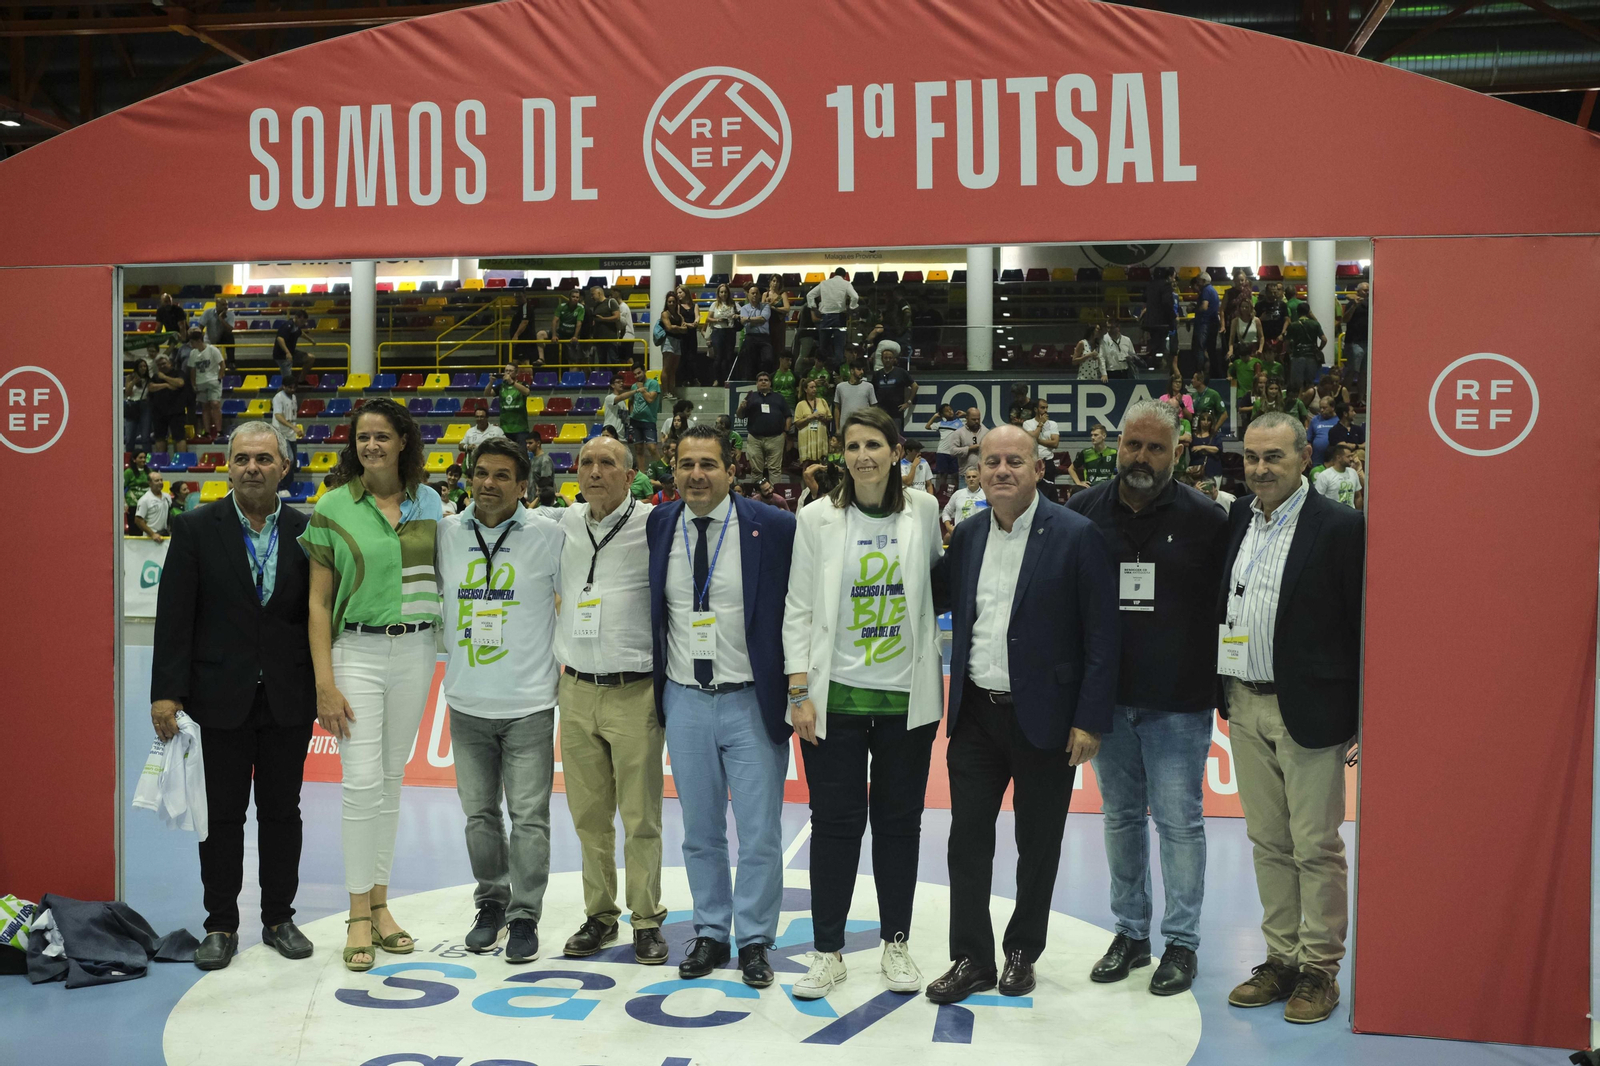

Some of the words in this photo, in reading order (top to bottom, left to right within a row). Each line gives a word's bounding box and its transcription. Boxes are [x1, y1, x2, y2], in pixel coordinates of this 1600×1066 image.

[915, 71, 1197, 189] FUTSAL
[250, 99, 487, 211] SOMOS
[522, 96, 598, 202] DE
[458, 589, 483, 600] ASCENSO
[850, 585, 879, 597] ASCENSO
[880, 584, 885, 596] A
[861, 626, 878, 638] COPA
[878, 626, 888, 637] DEL
[889, 625, 901, 637] REY
